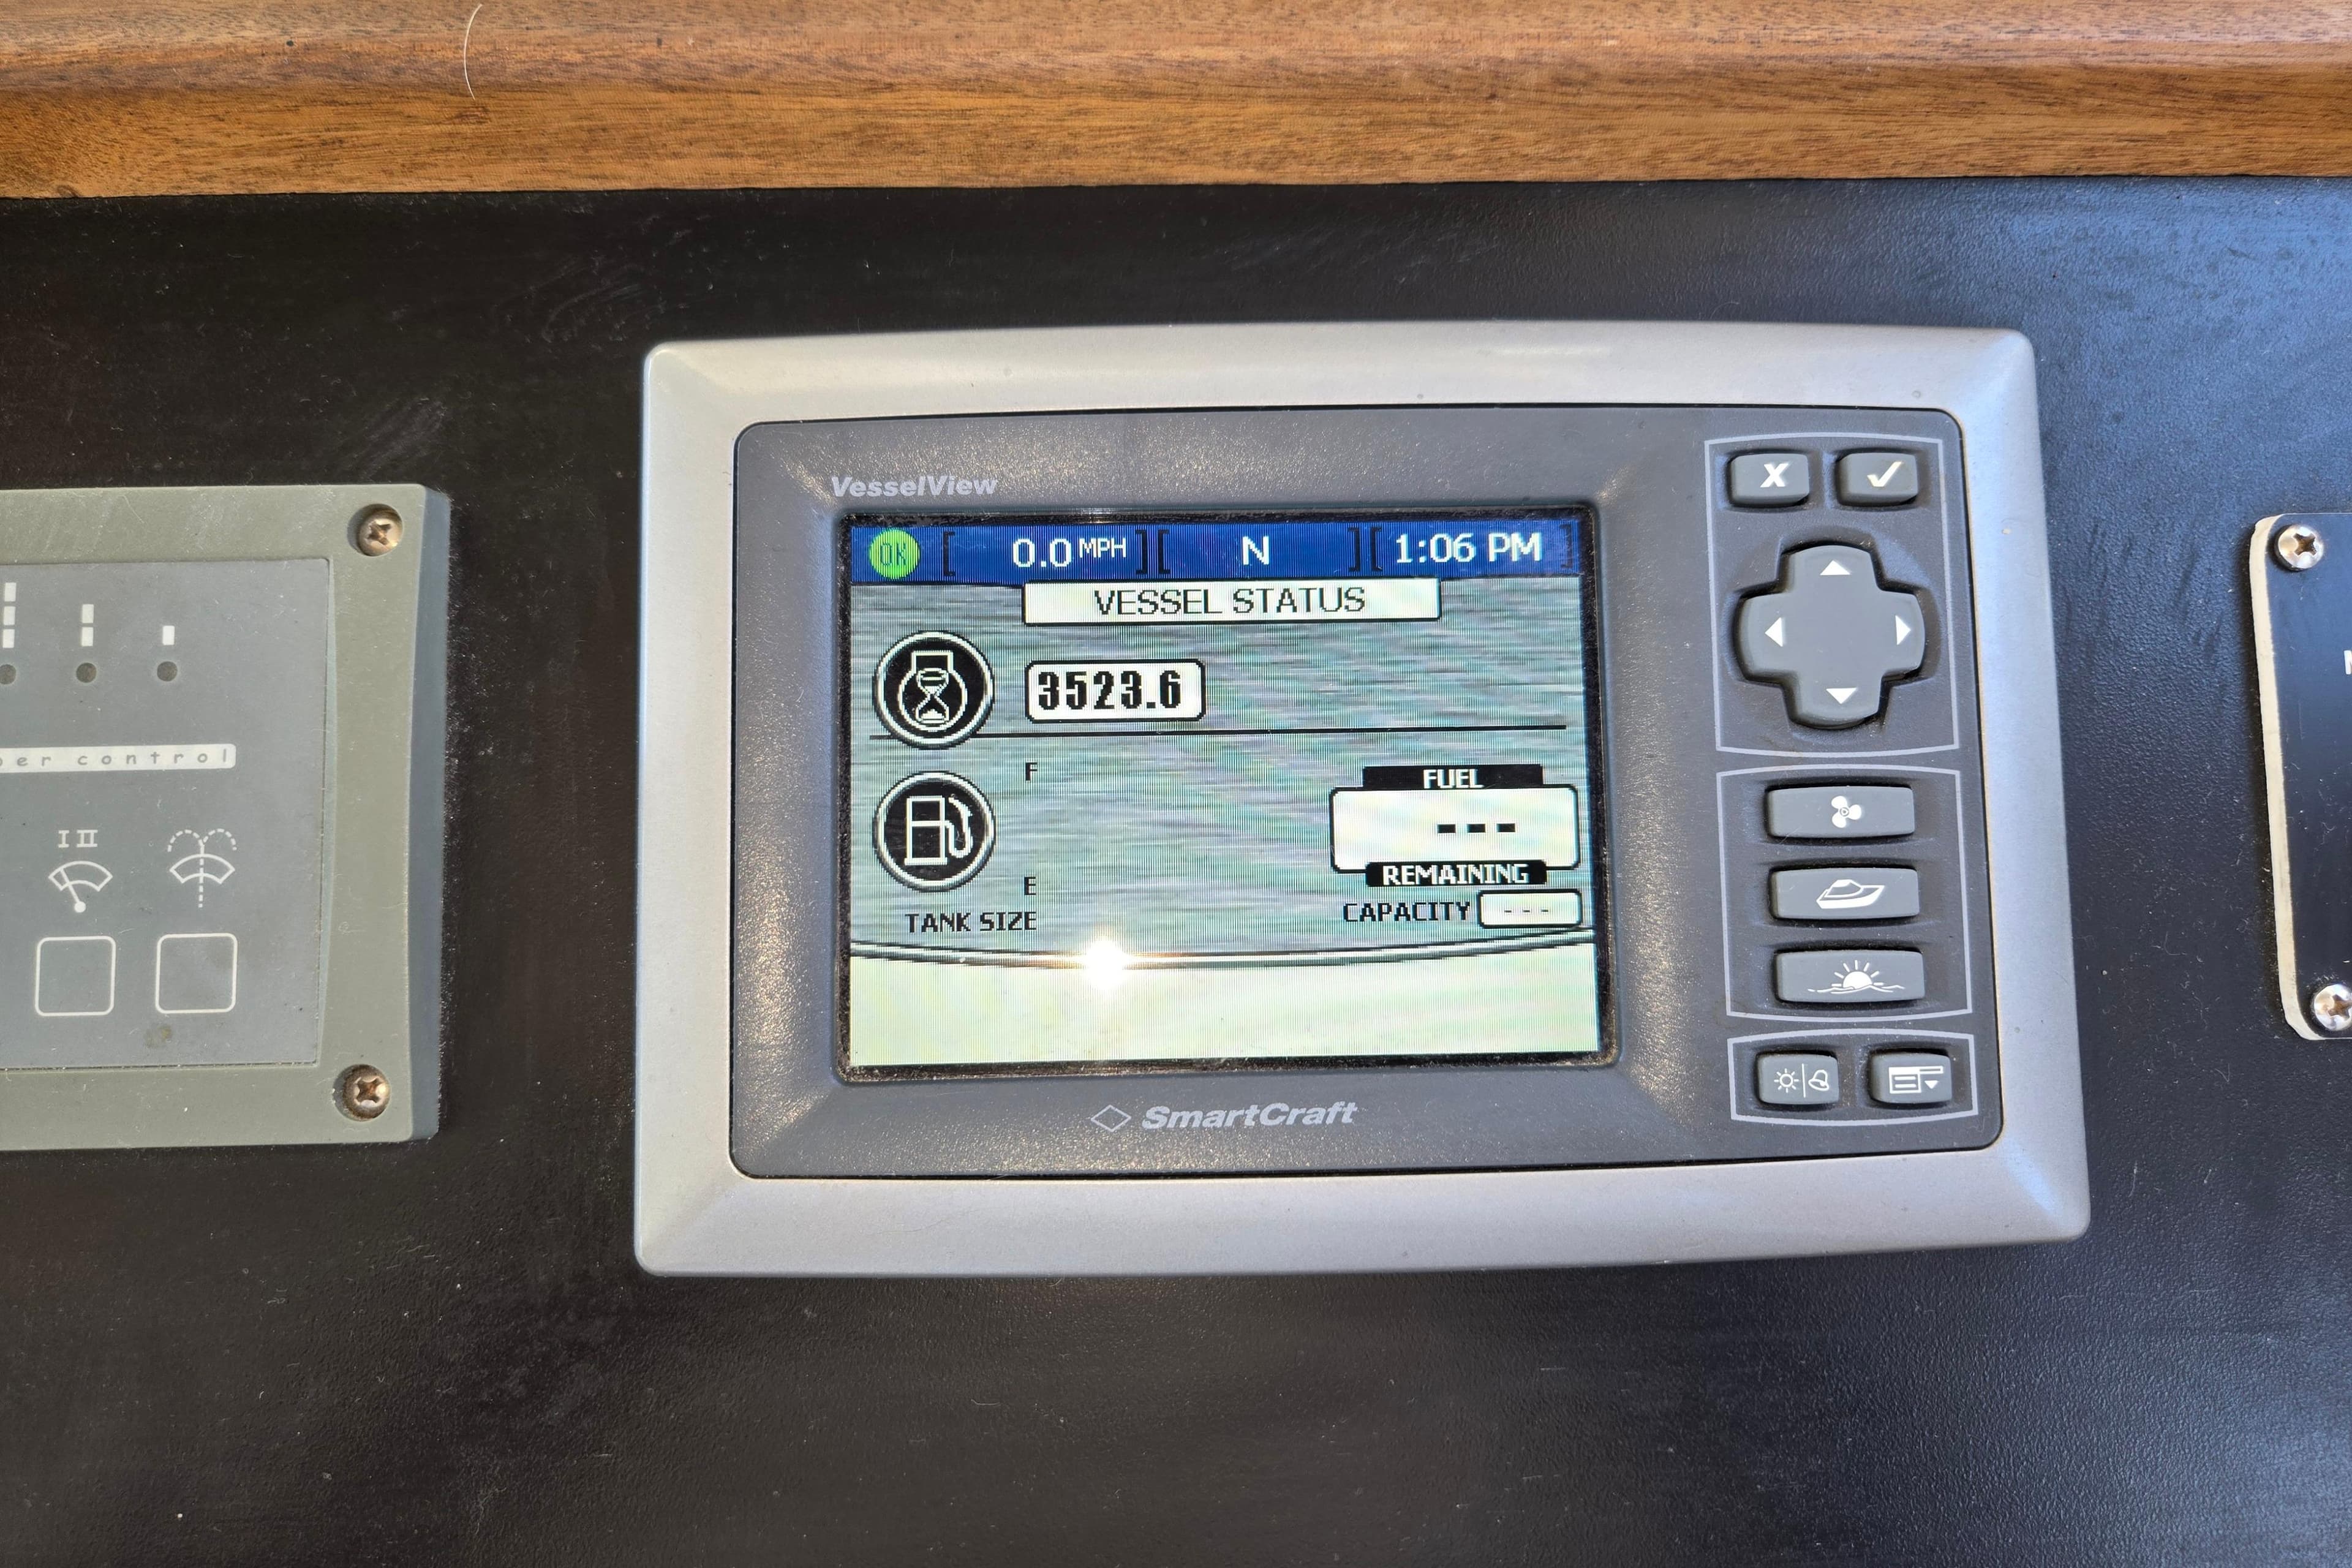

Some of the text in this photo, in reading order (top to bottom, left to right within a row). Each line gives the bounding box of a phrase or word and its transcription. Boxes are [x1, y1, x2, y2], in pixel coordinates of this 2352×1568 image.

[831, 476, 998, 497] VesselView
[879, 542, 907, 566] OK
[1012, 537, 1127, 568] 0.0 MPH
[1242, 535, 1270, 565] N
[1396, 532, 1543, 564] 1:06 PM
[1095, 586, 1366, 615] VESSEL STATUS
[1038, 669, 1182, 710] 3523.6
[77, 748, 228, 766] control
[1025, 763, 1039, 782] F
[1423, 769, 1483, 789] FUEL
[1024, 876, 1038, 895] E
[1382, 864, 1530, 886] REMAINING
[905, 911, 1037, 933] TANK SIZE
[1343, 902, 1471, 922] CAPACITY
[1141, 1101, 1359, 1129] SmartCraft
